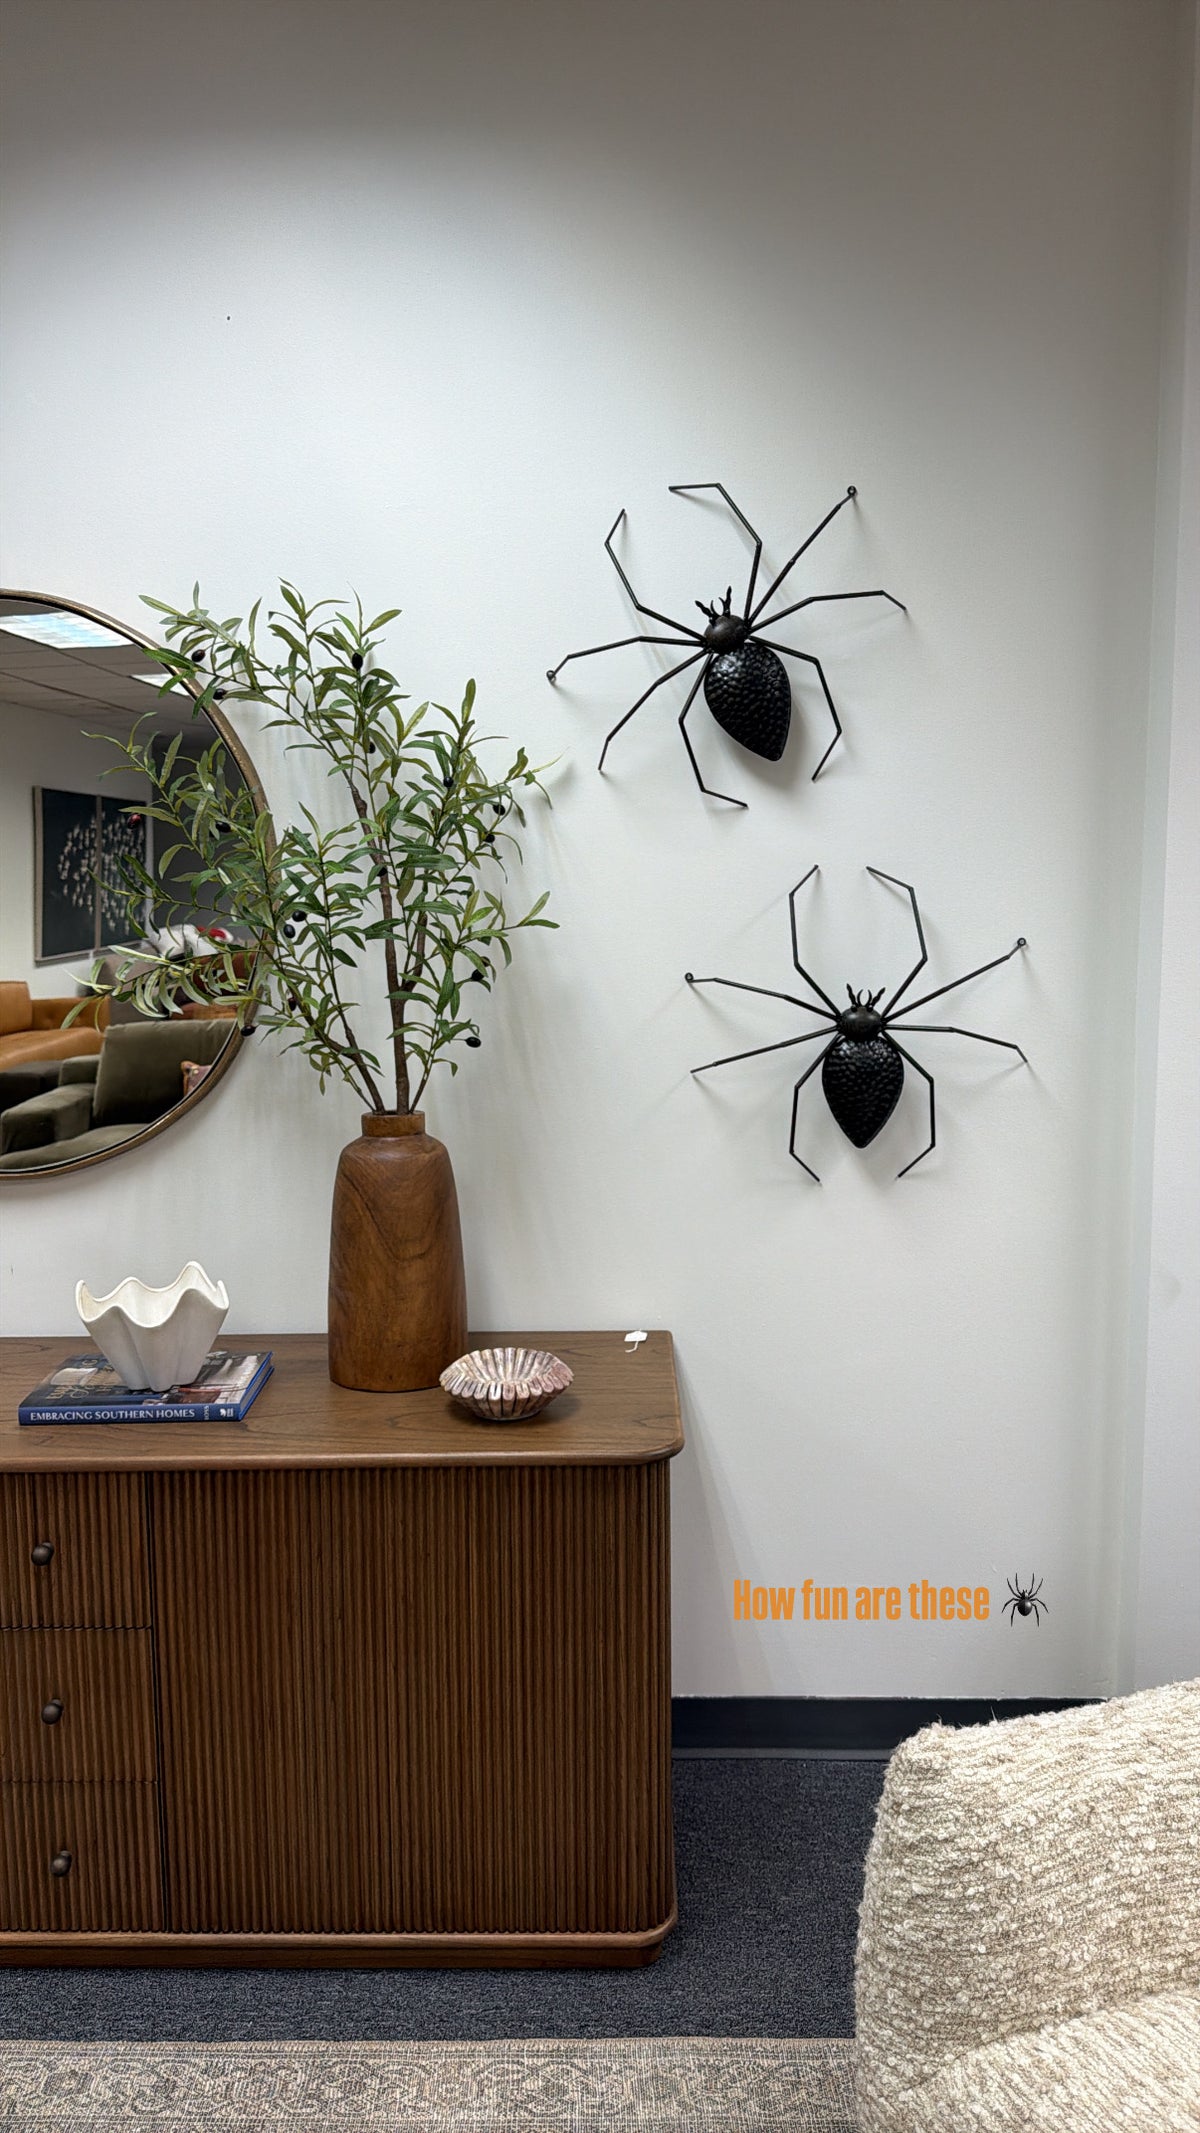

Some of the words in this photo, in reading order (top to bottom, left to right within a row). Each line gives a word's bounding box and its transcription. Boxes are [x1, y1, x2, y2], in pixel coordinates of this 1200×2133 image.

[30, 1411, 93, 1421] EMBRACING
[95, 1409, 153, 1420] SOUTHERN
[156, 1408, 195, 1418] HOMES
